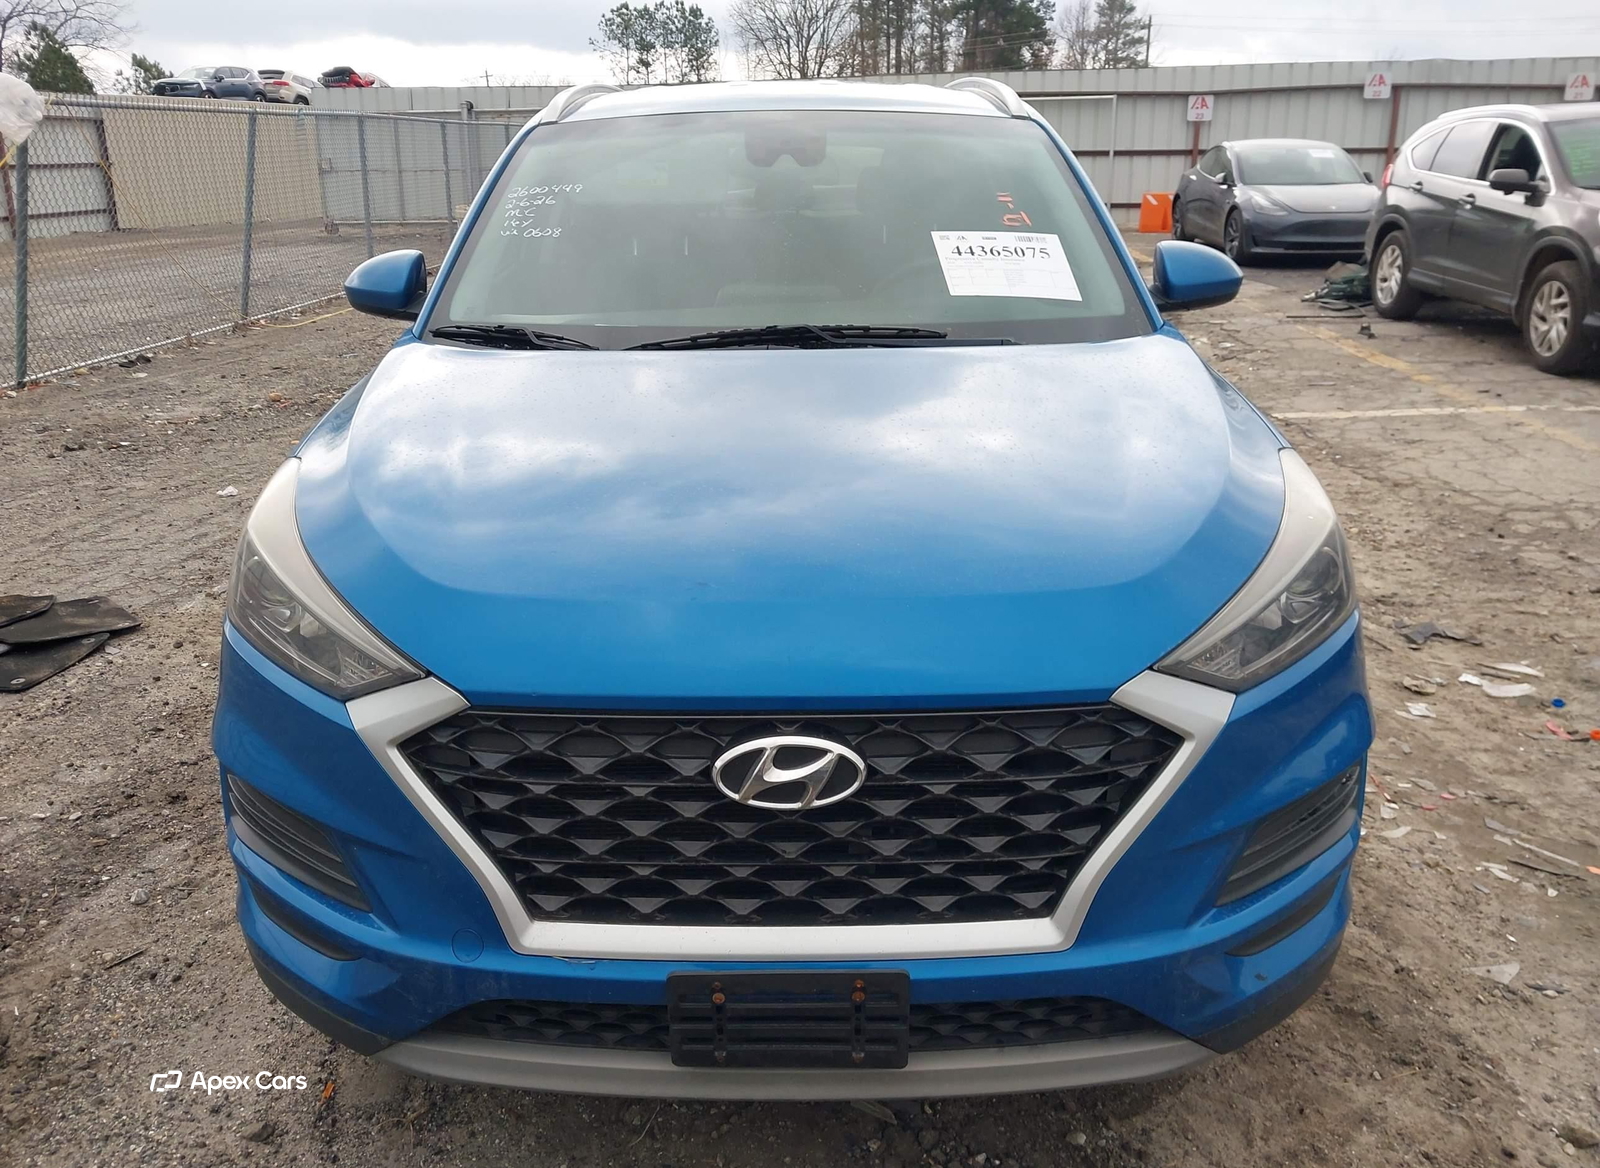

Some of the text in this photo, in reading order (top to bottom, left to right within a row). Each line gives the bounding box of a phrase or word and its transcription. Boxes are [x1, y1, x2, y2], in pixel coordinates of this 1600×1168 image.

[507, 184, 583, 198] 2600449
[505, 196, 556, 209] 2-6-26
[951, 245, 1050, 259] 44365075
